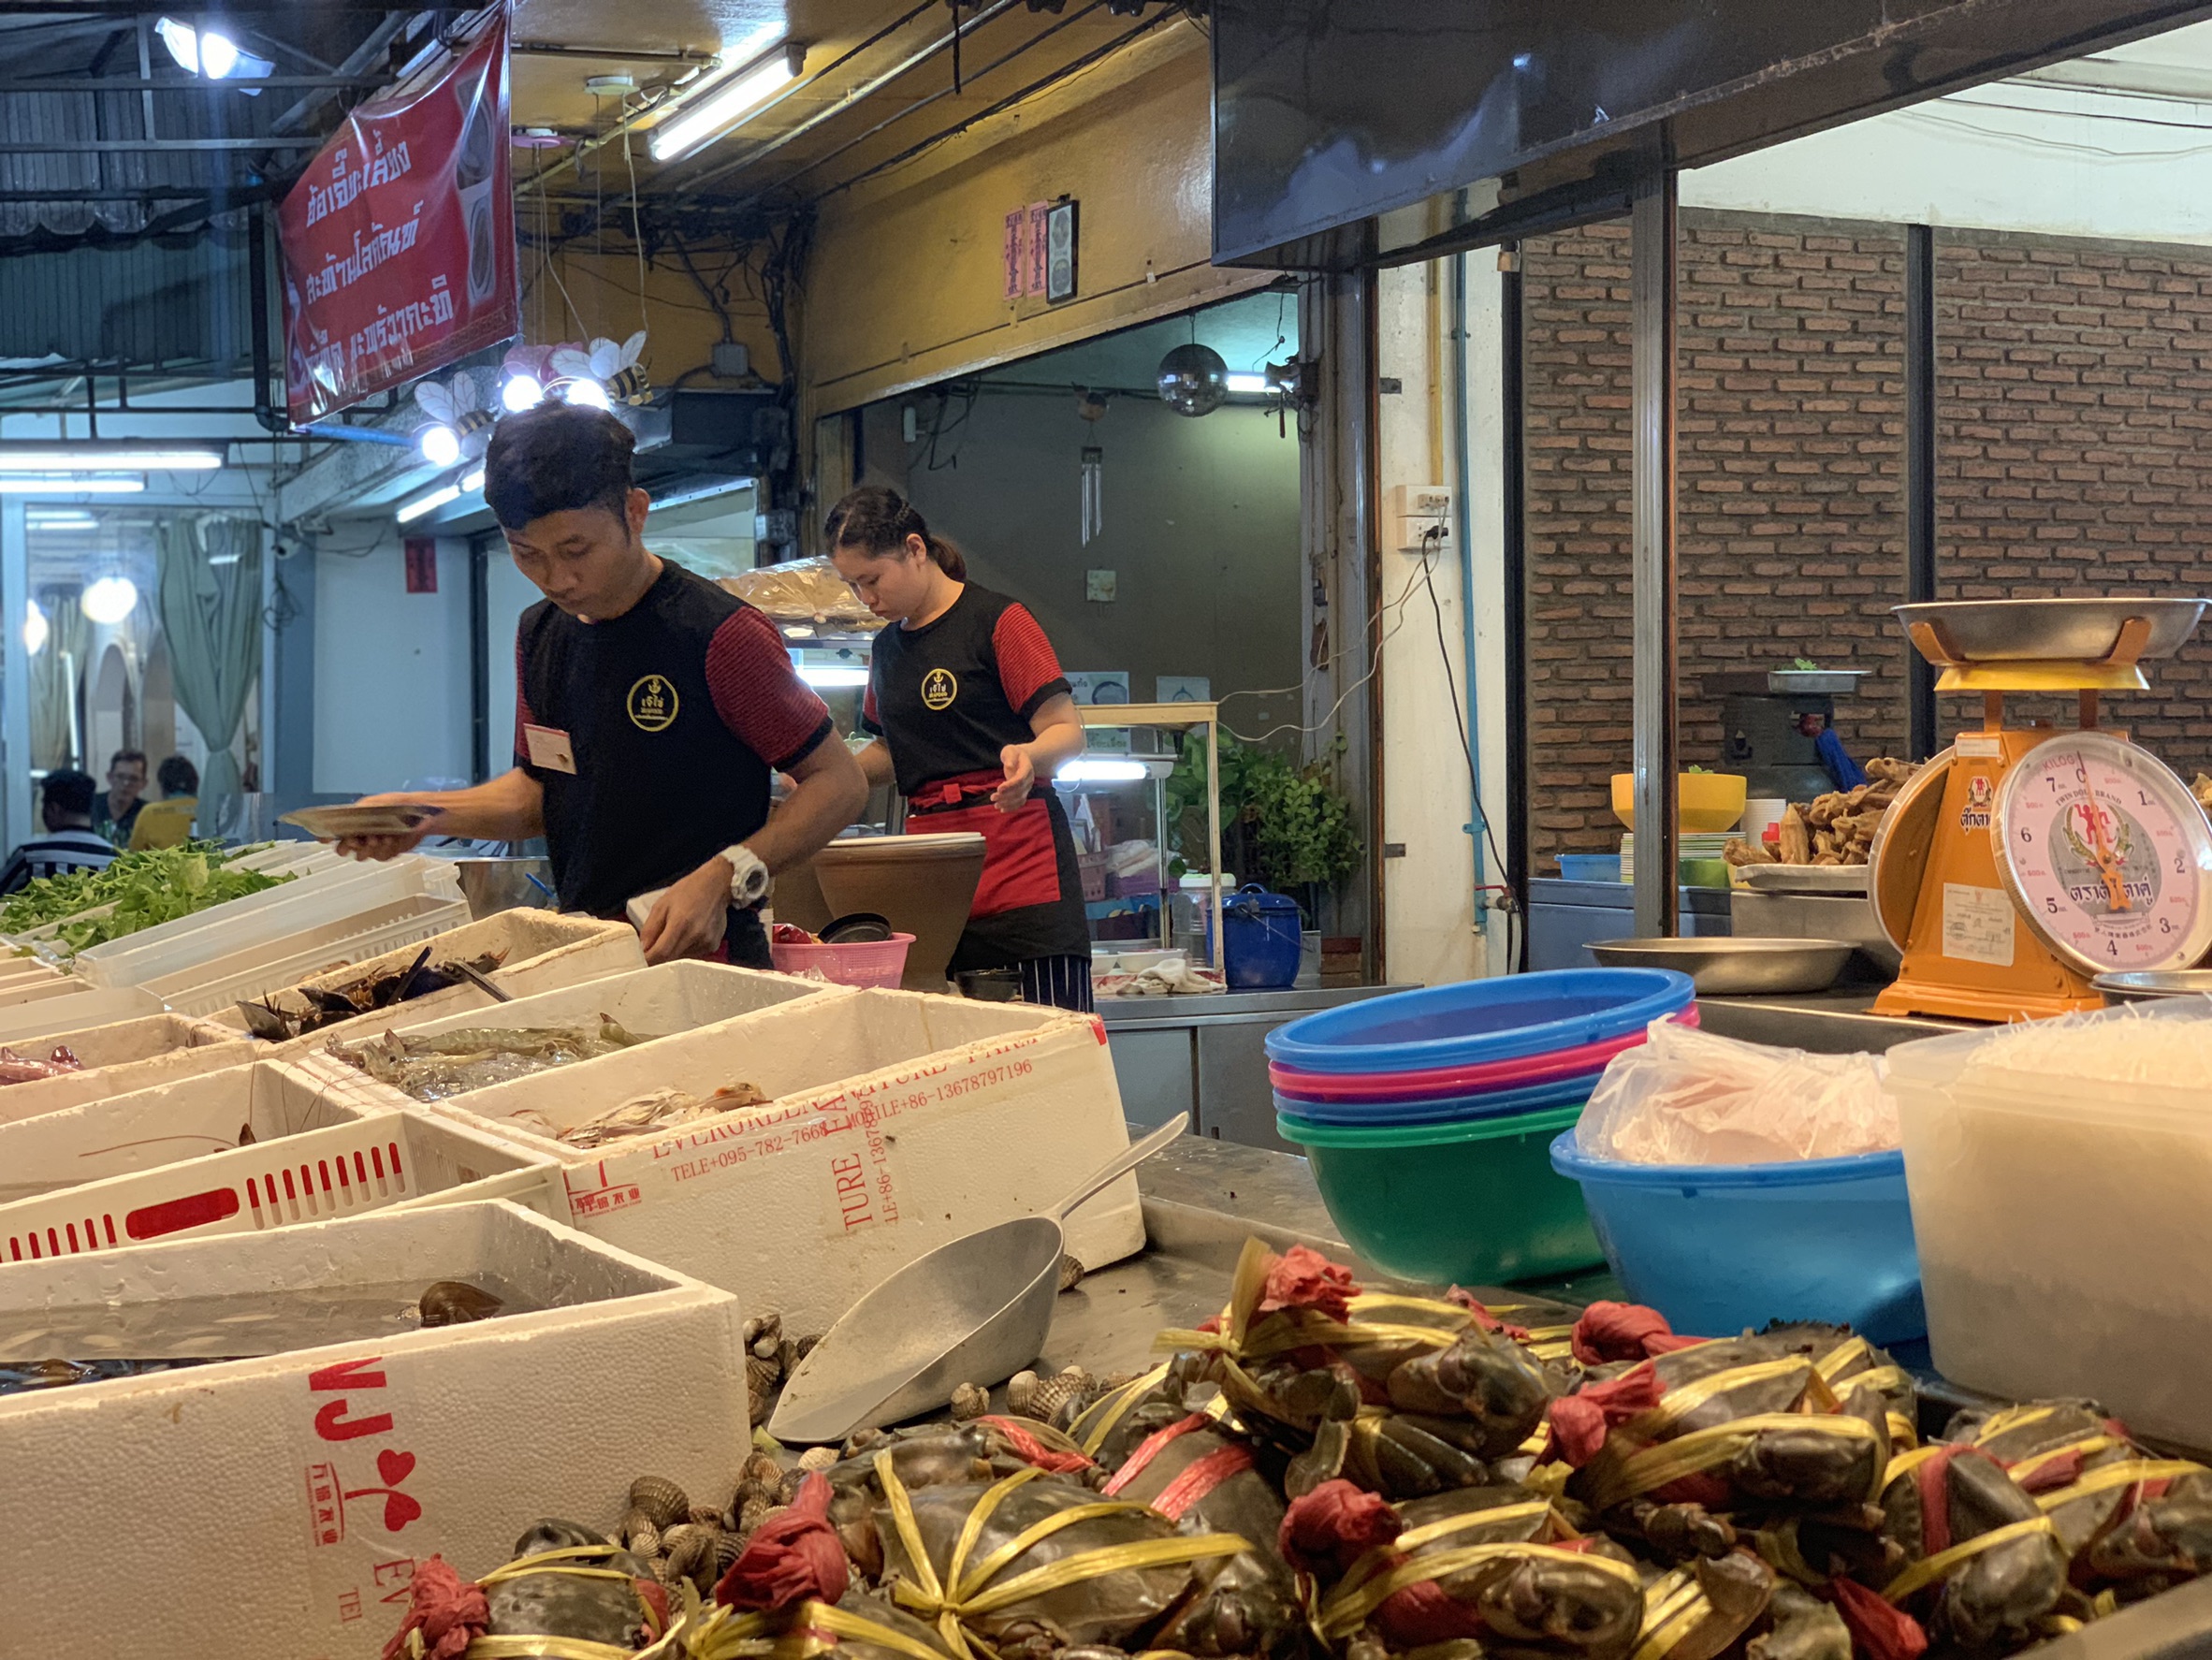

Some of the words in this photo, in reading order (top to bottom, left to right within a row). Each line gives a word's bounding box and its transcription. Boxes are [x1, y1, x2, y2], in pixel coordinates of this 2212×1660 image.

[2045, 777, 2056, 793] 7
[2137, 790, 2147, 806] 1
[2020, 827, 2032, 843] 6
[2174, 858, 2186, 874] 2
[2045, 897, 2058, 914] 5
[2160, 917, 2171, 934] 3
[2106, 939, 2117, 955] 4
[831, 1152, 873, 1231] TURE
